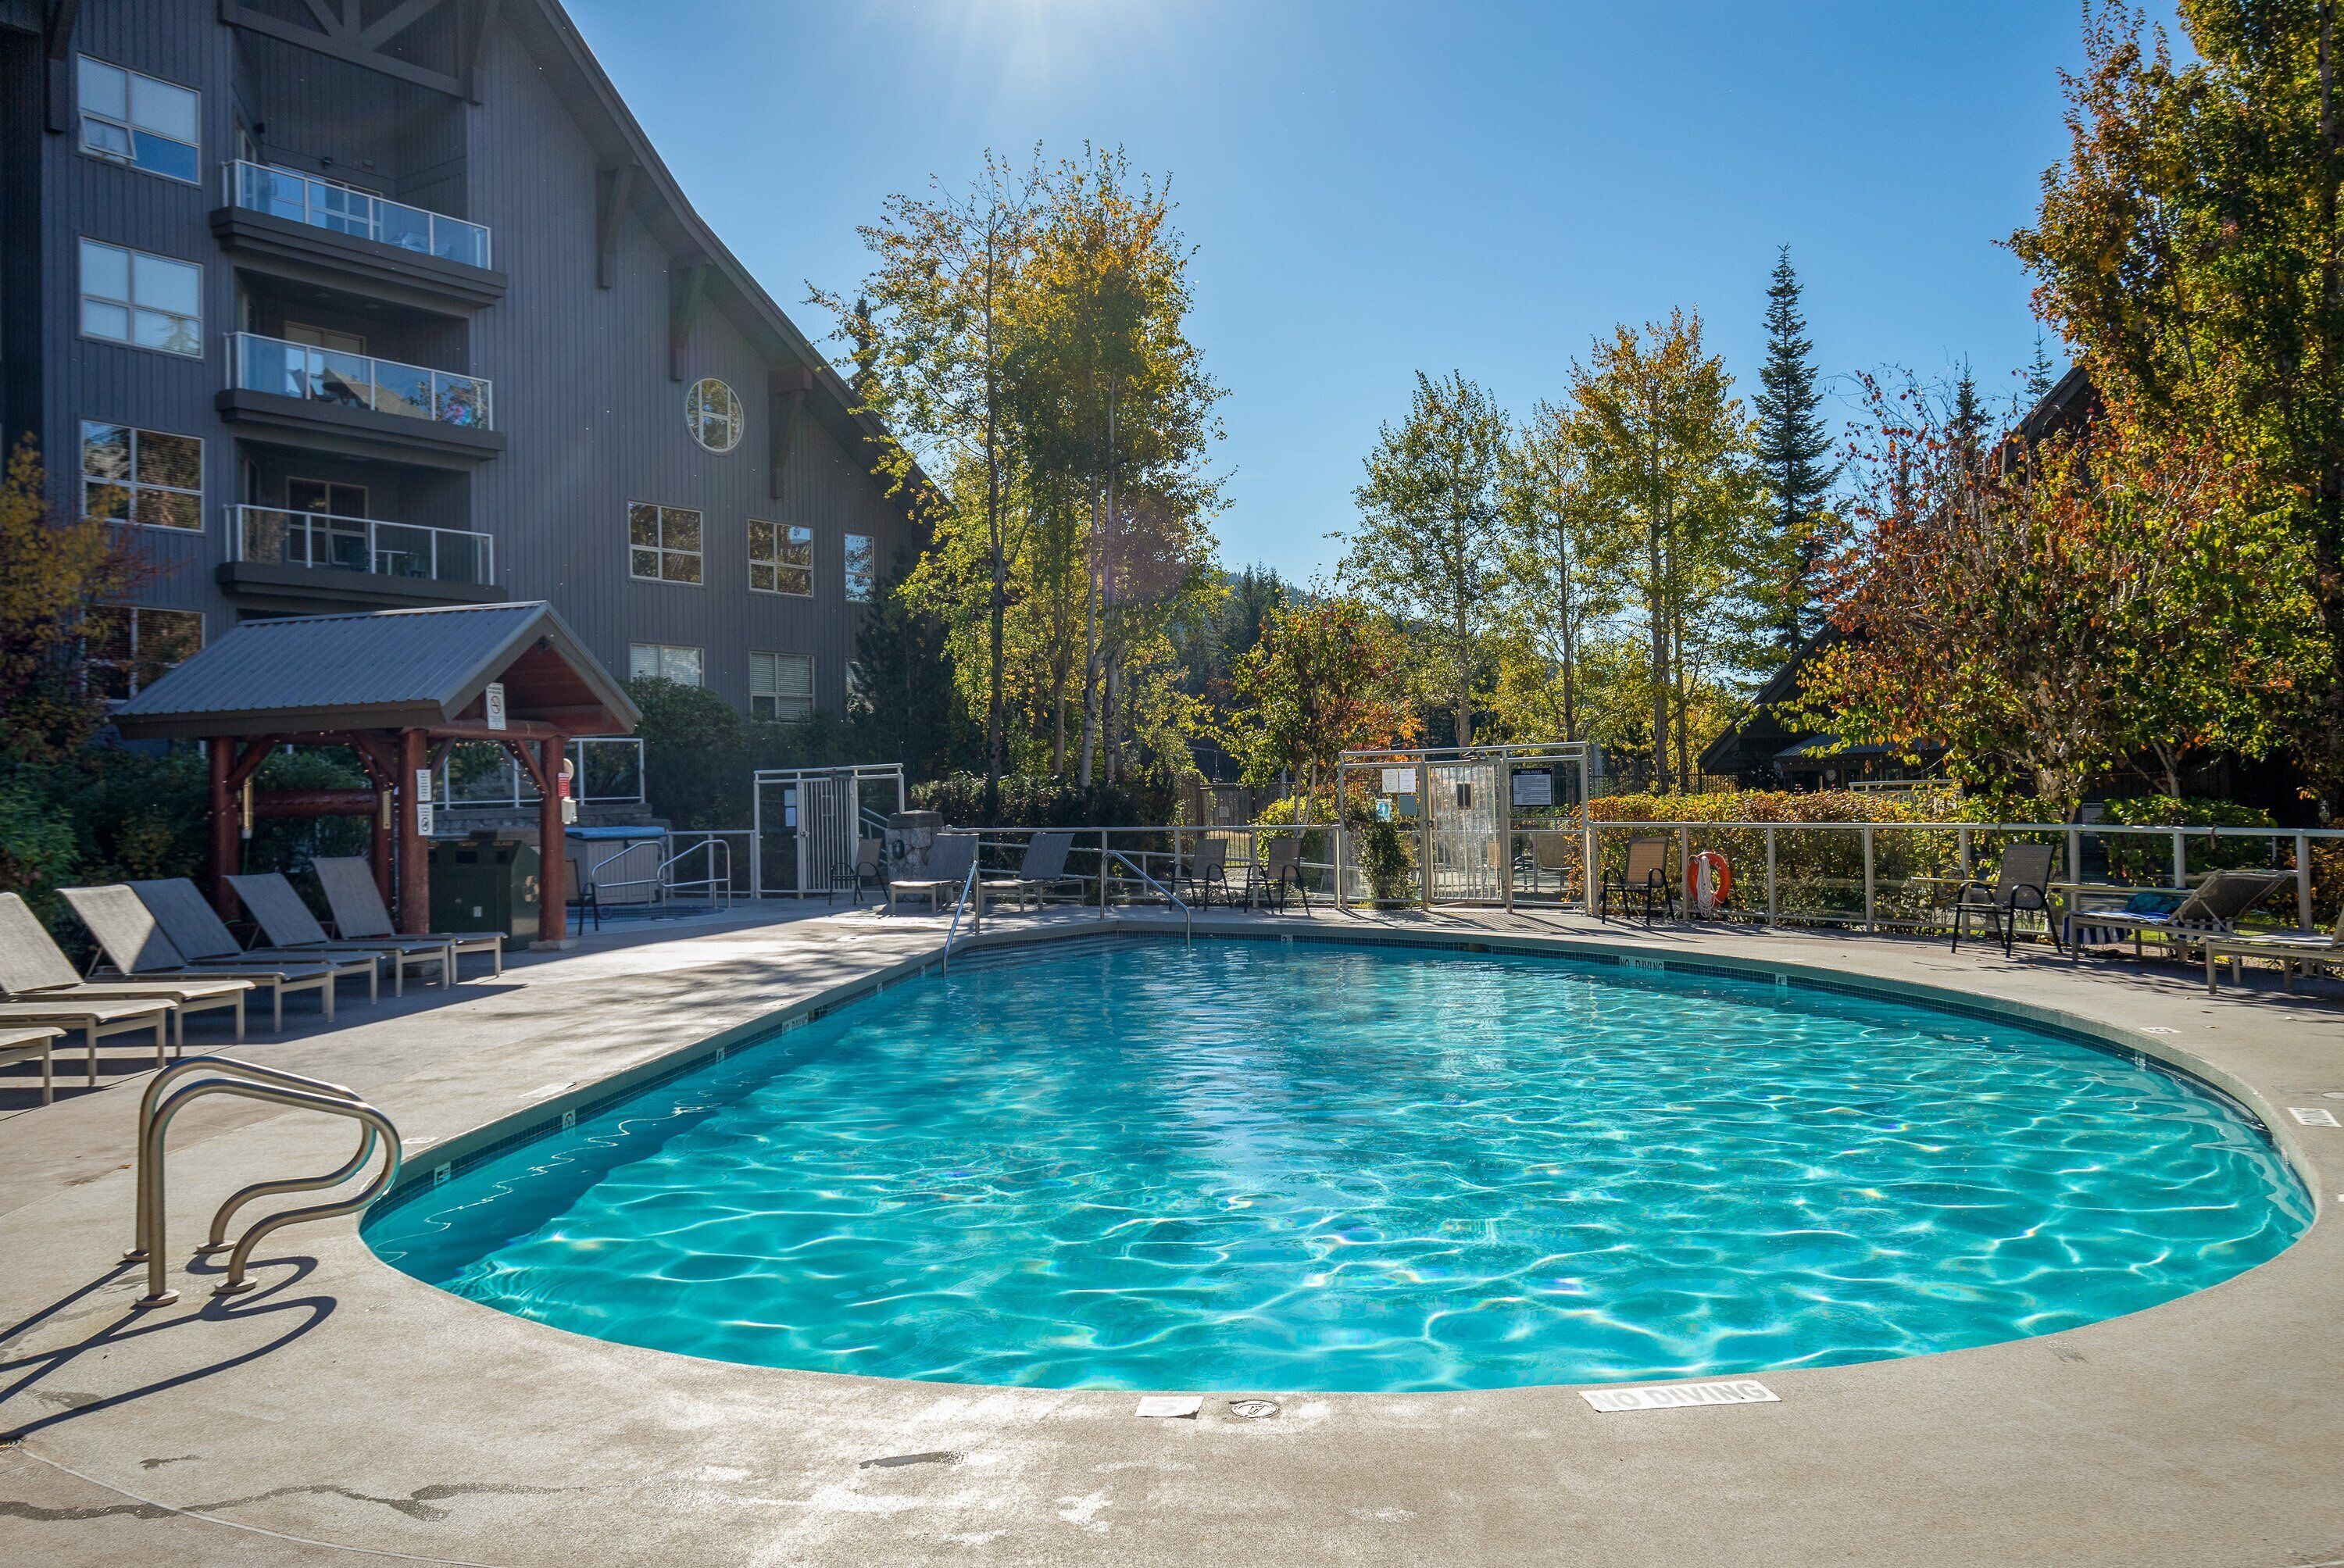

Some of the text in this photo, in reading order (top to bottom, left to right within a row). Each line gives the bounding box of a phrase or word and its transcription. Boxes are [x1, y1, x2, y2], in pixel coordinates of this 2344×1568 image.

[1620, 958, 1663, 971] NO DIVING
[1588, 1382, 1767, 1409] NO DIVING
